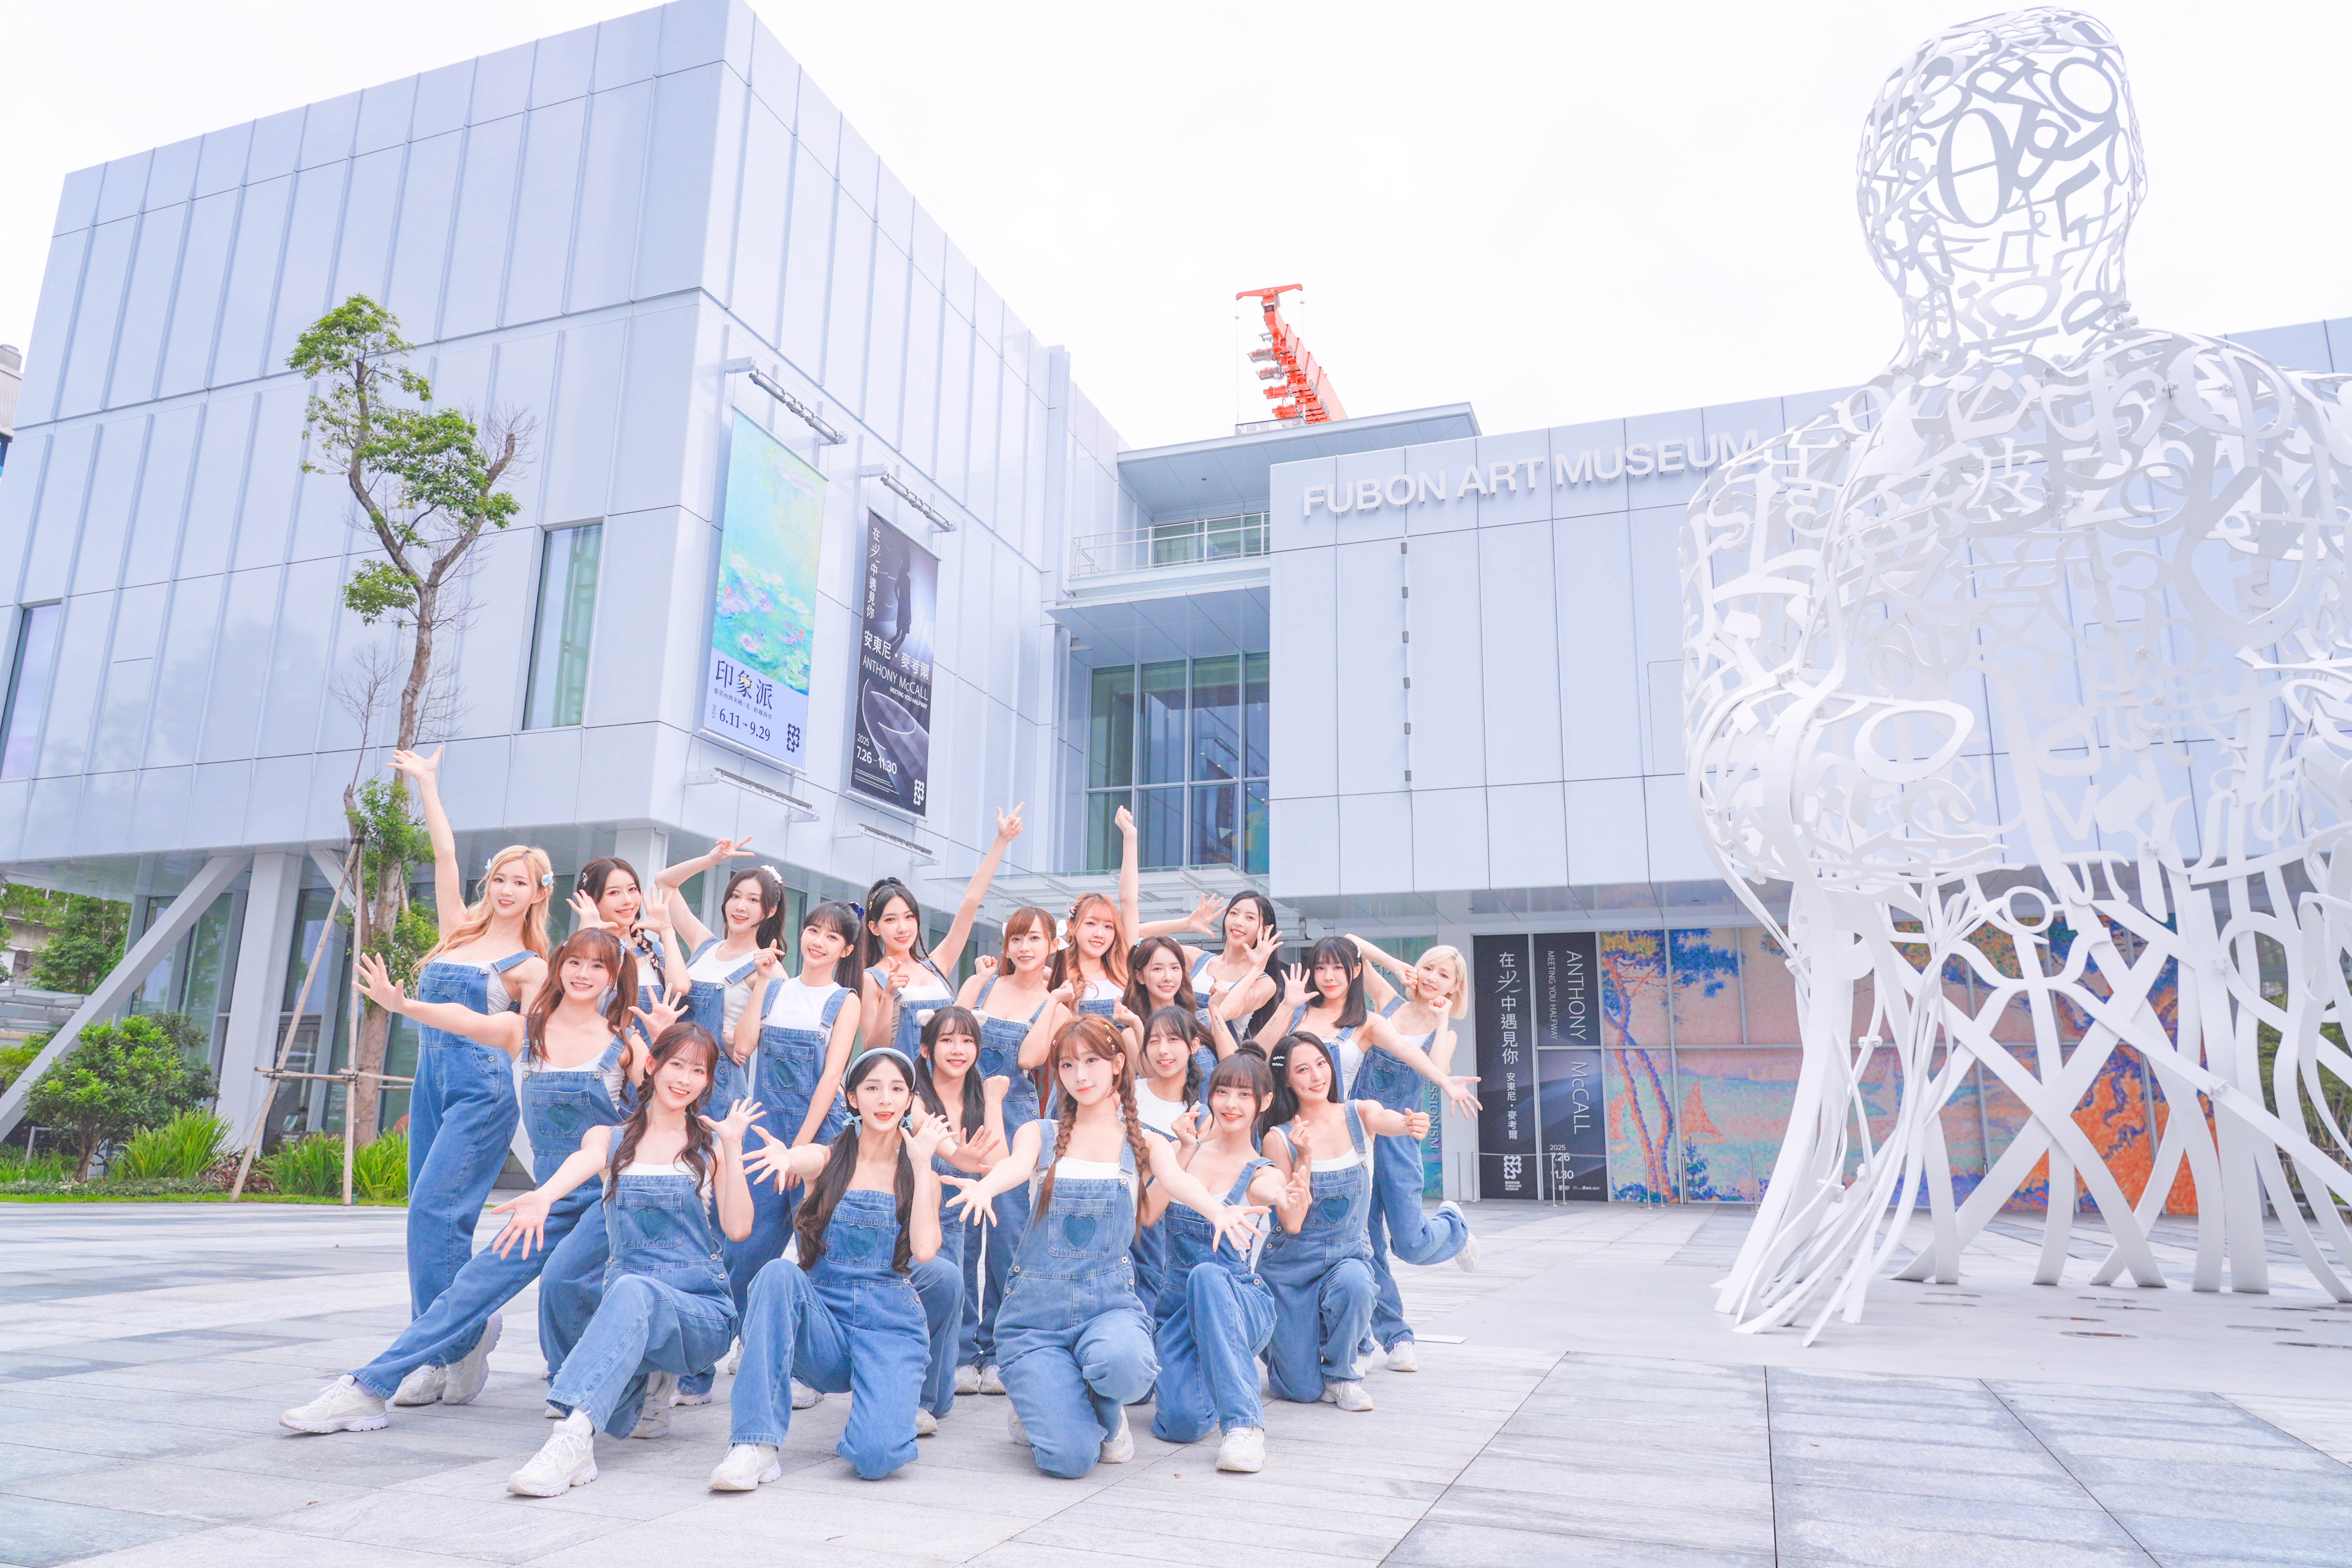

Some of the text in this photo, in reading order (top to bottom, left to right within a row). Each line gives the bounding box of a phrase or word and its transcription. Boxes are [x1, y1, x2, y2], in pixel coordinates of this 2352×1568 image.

[1303, 428, 1759, 517] FUBON ART MUSEUM
[715, 660, 773, 710] 印象派
[862, 655, 928, 701] ANTHONY McCALL
[890, 686, 904, 698] MEETING
[912, 697, 928, 709] HALFWAY
[857, 733, 869, 746] 2025
[1548, 951, 1556, 984] MEETING
[1494, 952, 1521, 1065] 在光中遇見你
[1550, 1004, 1559, 1040] HALFWAY
[1566, 951, 1591, 1134] ANTHONY McCALL
[1551, 1170, 1574, 1179] 1.30
